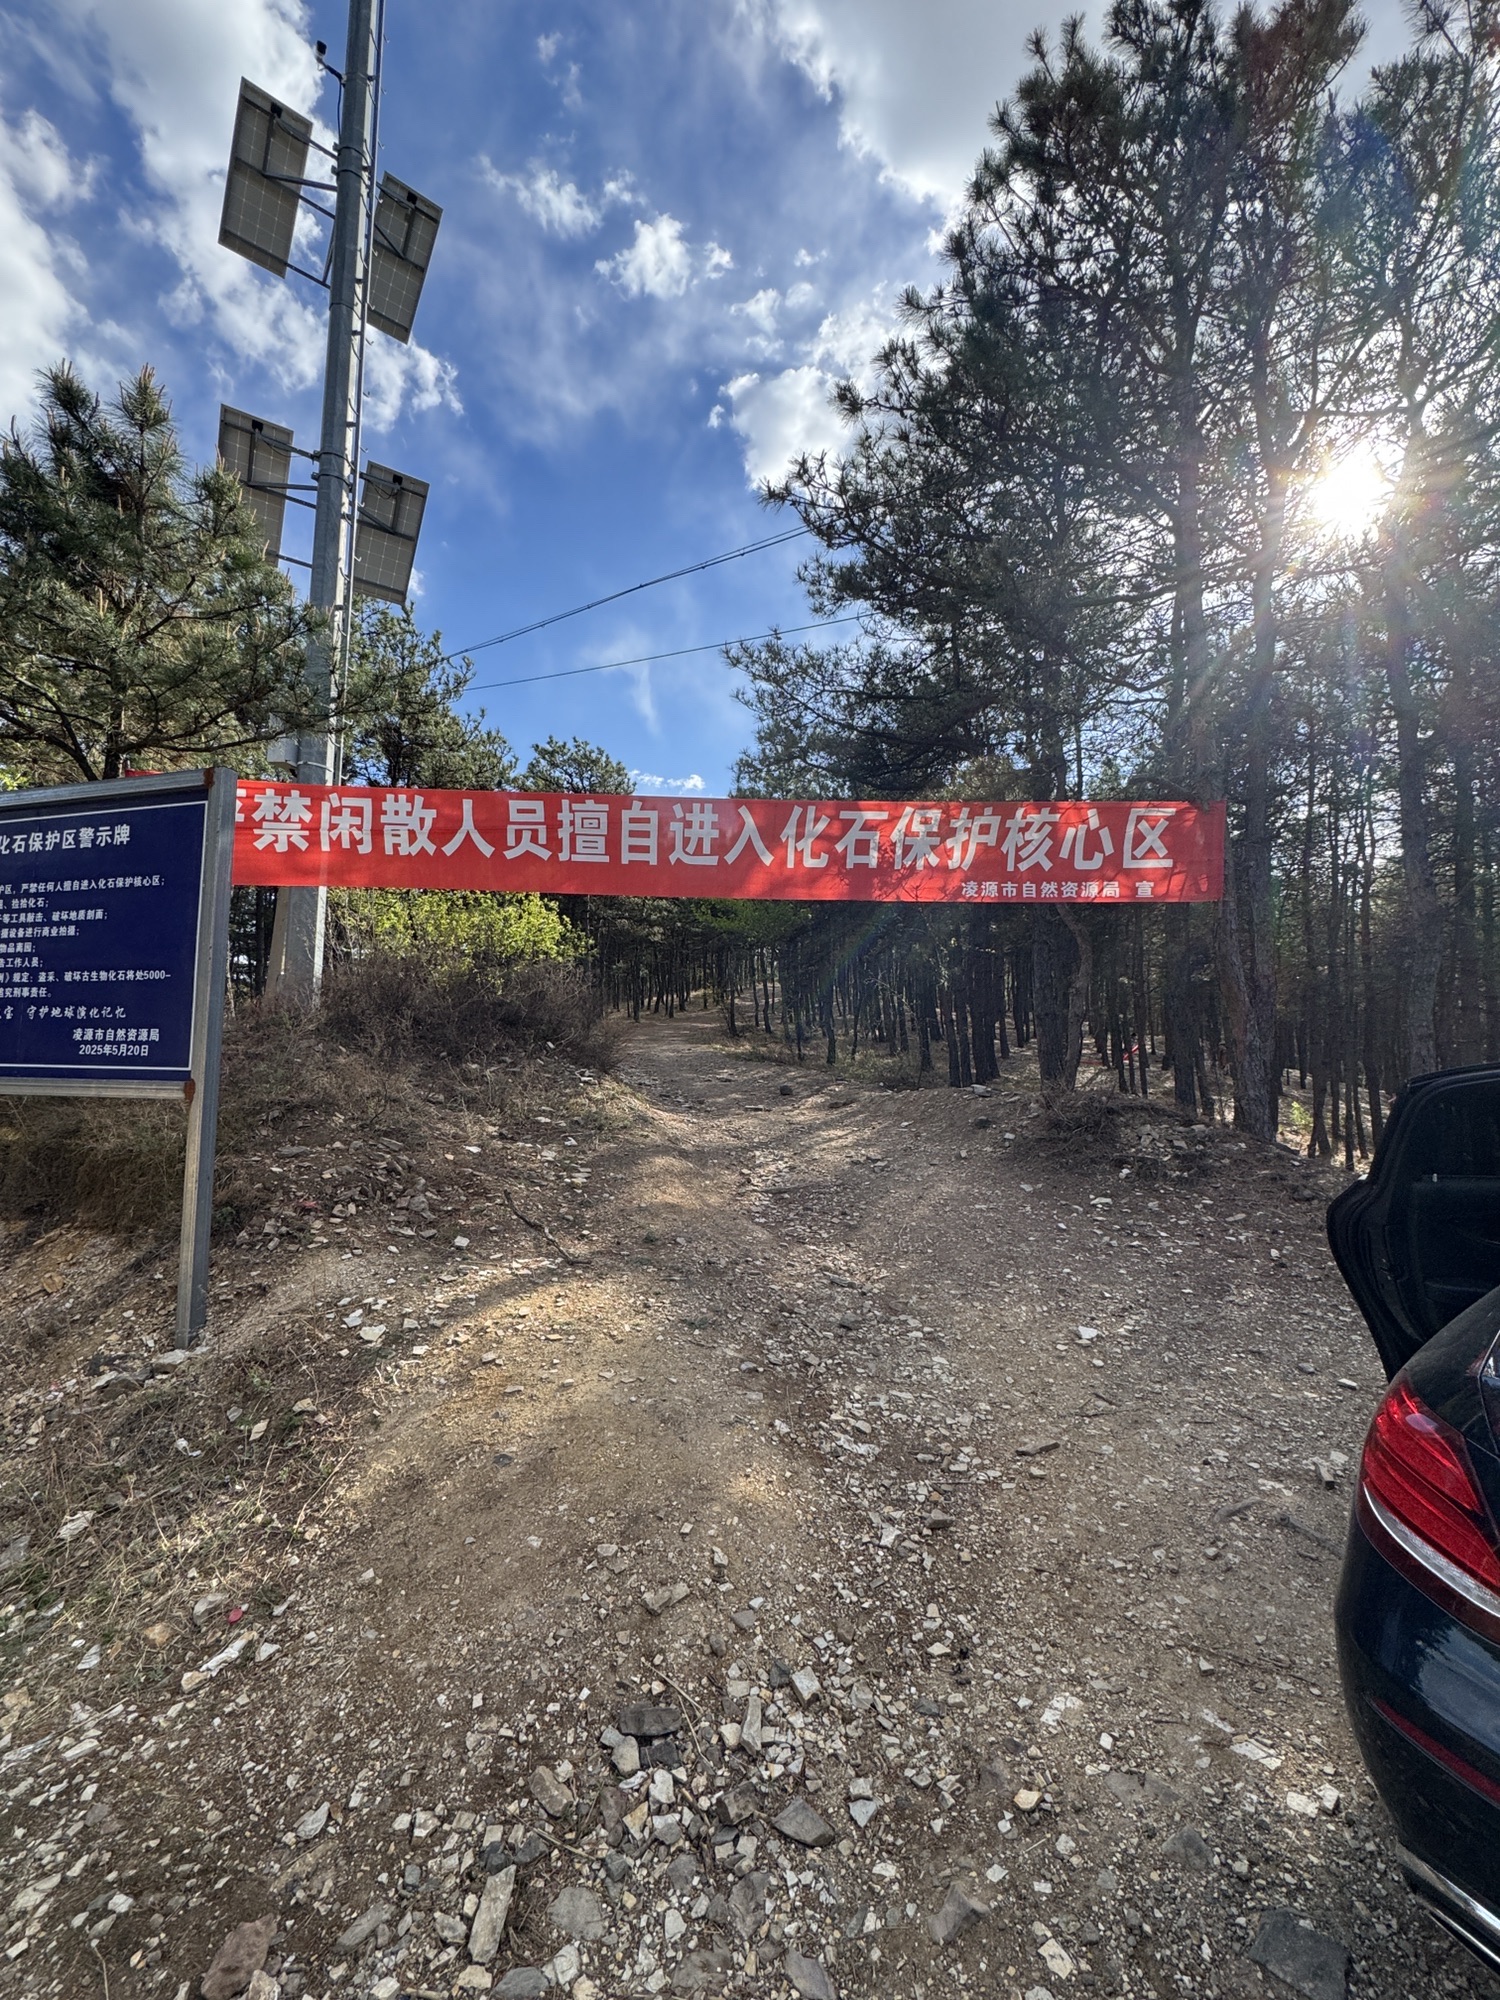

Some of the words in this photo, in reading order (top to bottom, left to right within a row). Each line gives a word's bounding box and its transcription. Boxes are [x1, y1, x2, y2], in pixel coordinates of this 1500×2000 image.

[235, 788, 1175, 871] 禁闲散人员擅自进入化石保护核心区
[0, 824, 130, 854] 化石保护区警示牌
[961, 880, 1120, 898] 凌源市自然资源局
[1135, 881, 1155, 898] 宣
[0, 909, 107, 923] 等工具敲击、破坏地质剖面；
[0, 1006, 13, 1019] 宝
[73, 1028, 159, 1041] 凌源市自然资源局
[79, 1044, 148, 1056] 2025年5月20日
